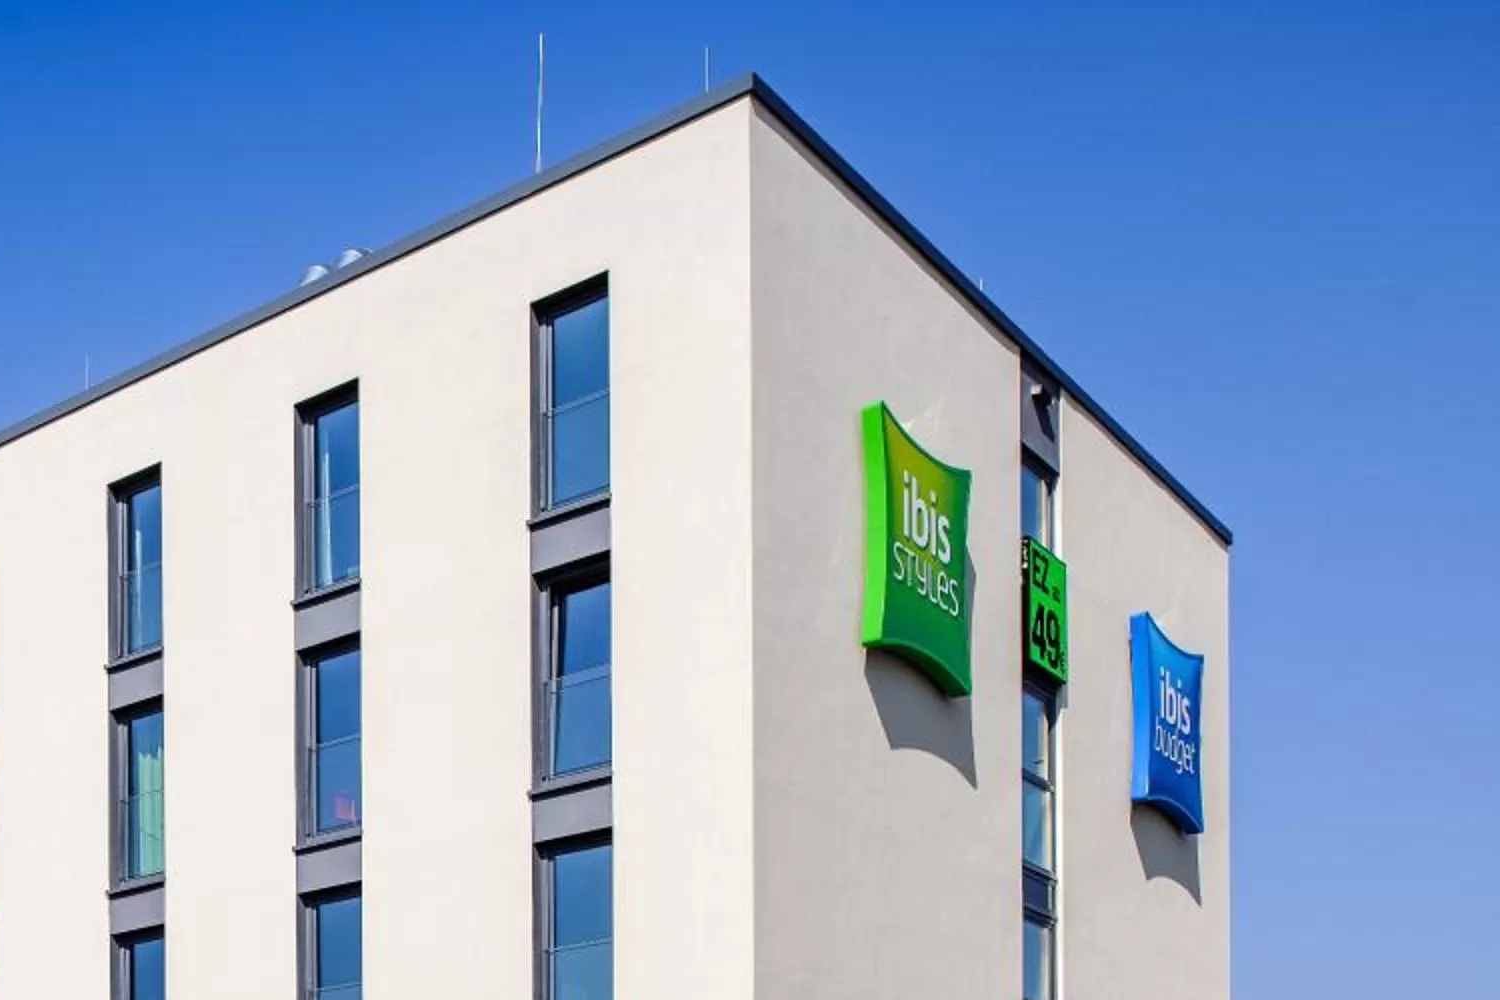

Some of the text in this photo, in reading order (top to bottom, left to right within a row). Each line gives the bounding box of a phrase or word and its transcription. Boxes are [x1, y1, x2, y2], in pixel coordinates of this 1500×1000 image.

[902, 468, 952, 565] ibis
[1032, 547, 1050, 596] EZ
[1159, 665, 1192, 736] ibis
[1155, 715, 1196, 776] budget
